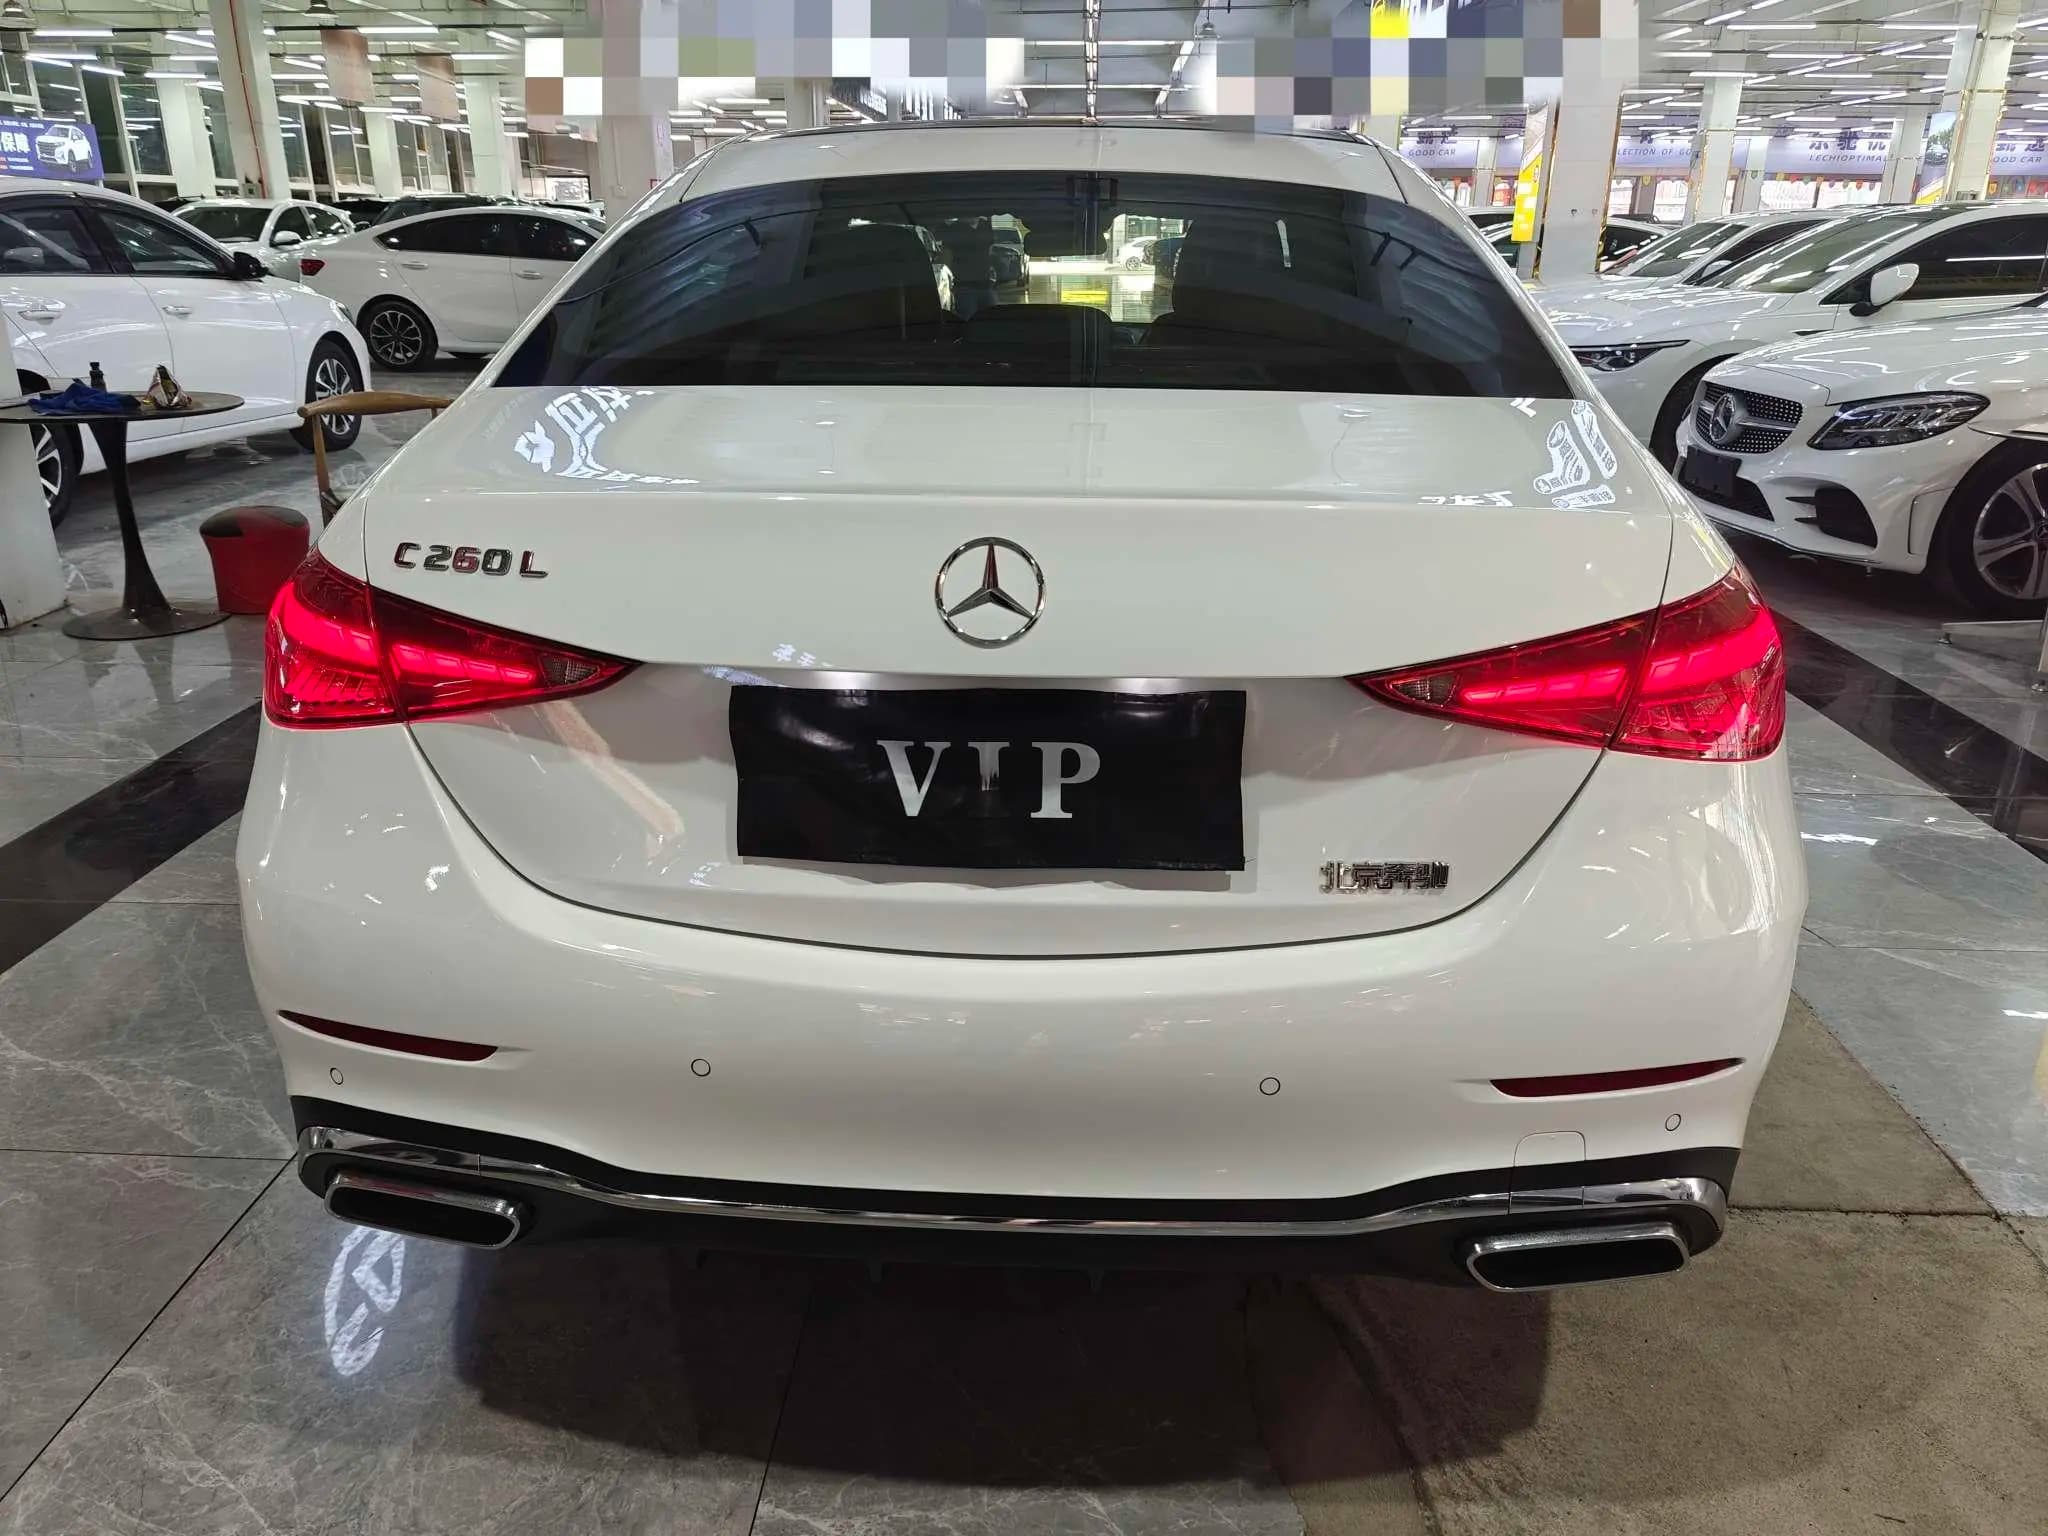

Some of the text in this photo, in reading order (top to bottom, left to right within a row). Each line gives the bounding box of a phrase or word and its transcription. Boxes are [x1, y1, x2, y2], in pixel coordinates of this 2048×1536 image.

[1408, 149, 1435, 157] GOOD
[877, 739, 1100, 818] VIP
[1320, 860, 1449, 891] 北京奔驰
